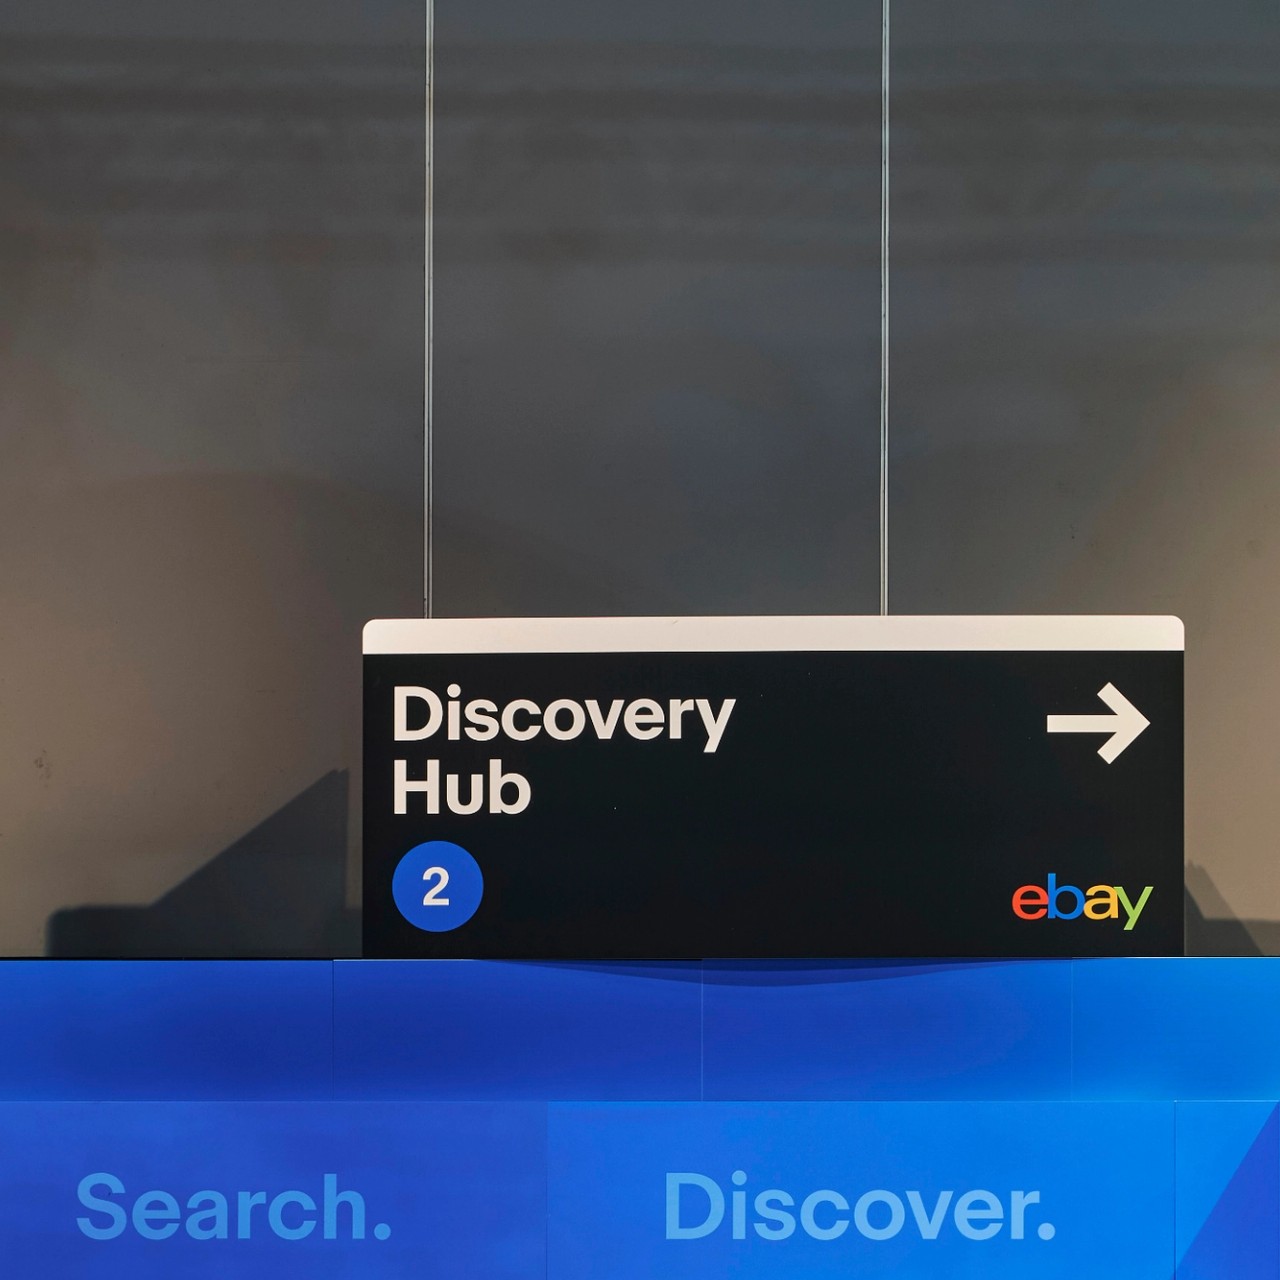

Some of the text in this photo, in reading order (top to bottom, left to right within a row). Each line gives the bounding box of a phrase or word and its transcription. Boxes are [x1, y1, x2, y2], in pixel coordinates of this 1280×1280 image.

[393, 684, 736, 753] Discovery
[393, 759, 531, 815] Hub
[422, 866, 450, 906] 2
[1013, 873, 1153, 930] ebay
[76, 1171, 392, 1241] Search.
[666, 1170, 1056, 1241] Discover.
